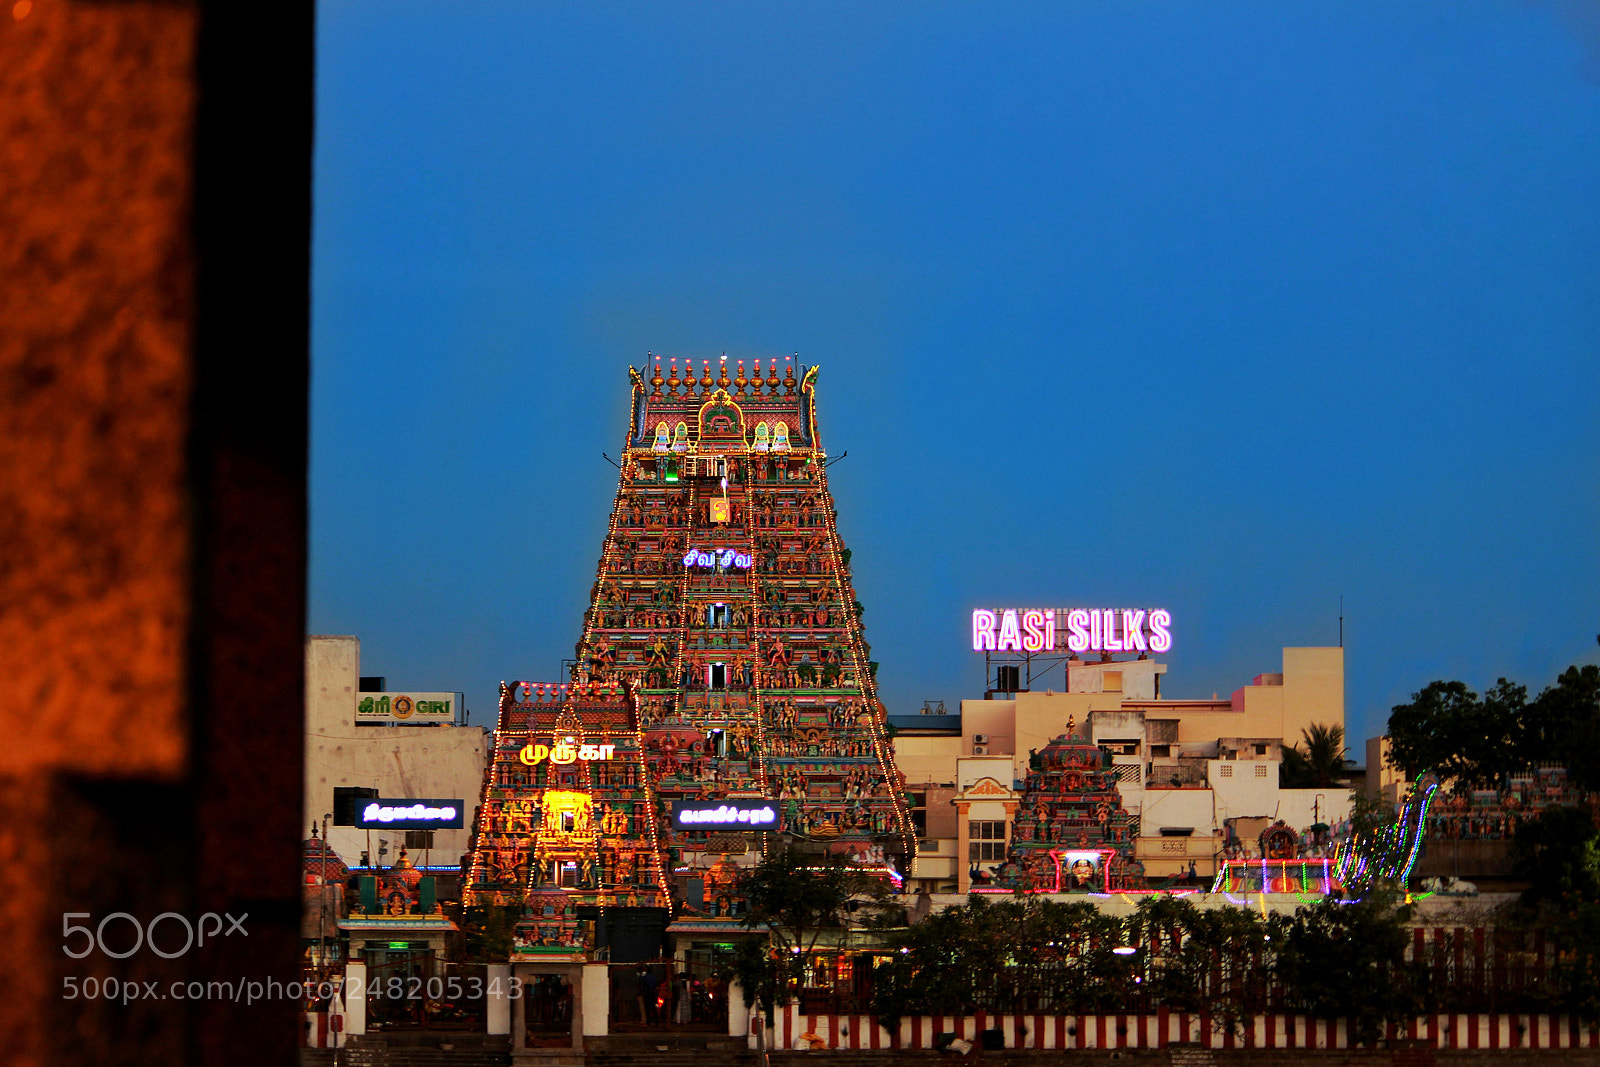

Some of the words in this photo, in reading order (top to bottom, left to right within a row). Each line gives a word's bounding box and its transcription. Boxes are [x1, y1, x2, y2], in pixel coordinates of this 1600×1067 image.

[683, 548, 715, 567] சிவ
[720, 549, 752, 568] சிவ
[1067, 609, 1173, 652] SILKS
[358, 695, 390, 713] கிரி
[416, 700, 450, 713] GIRI
[519, 744, 615, 766] முருகா
